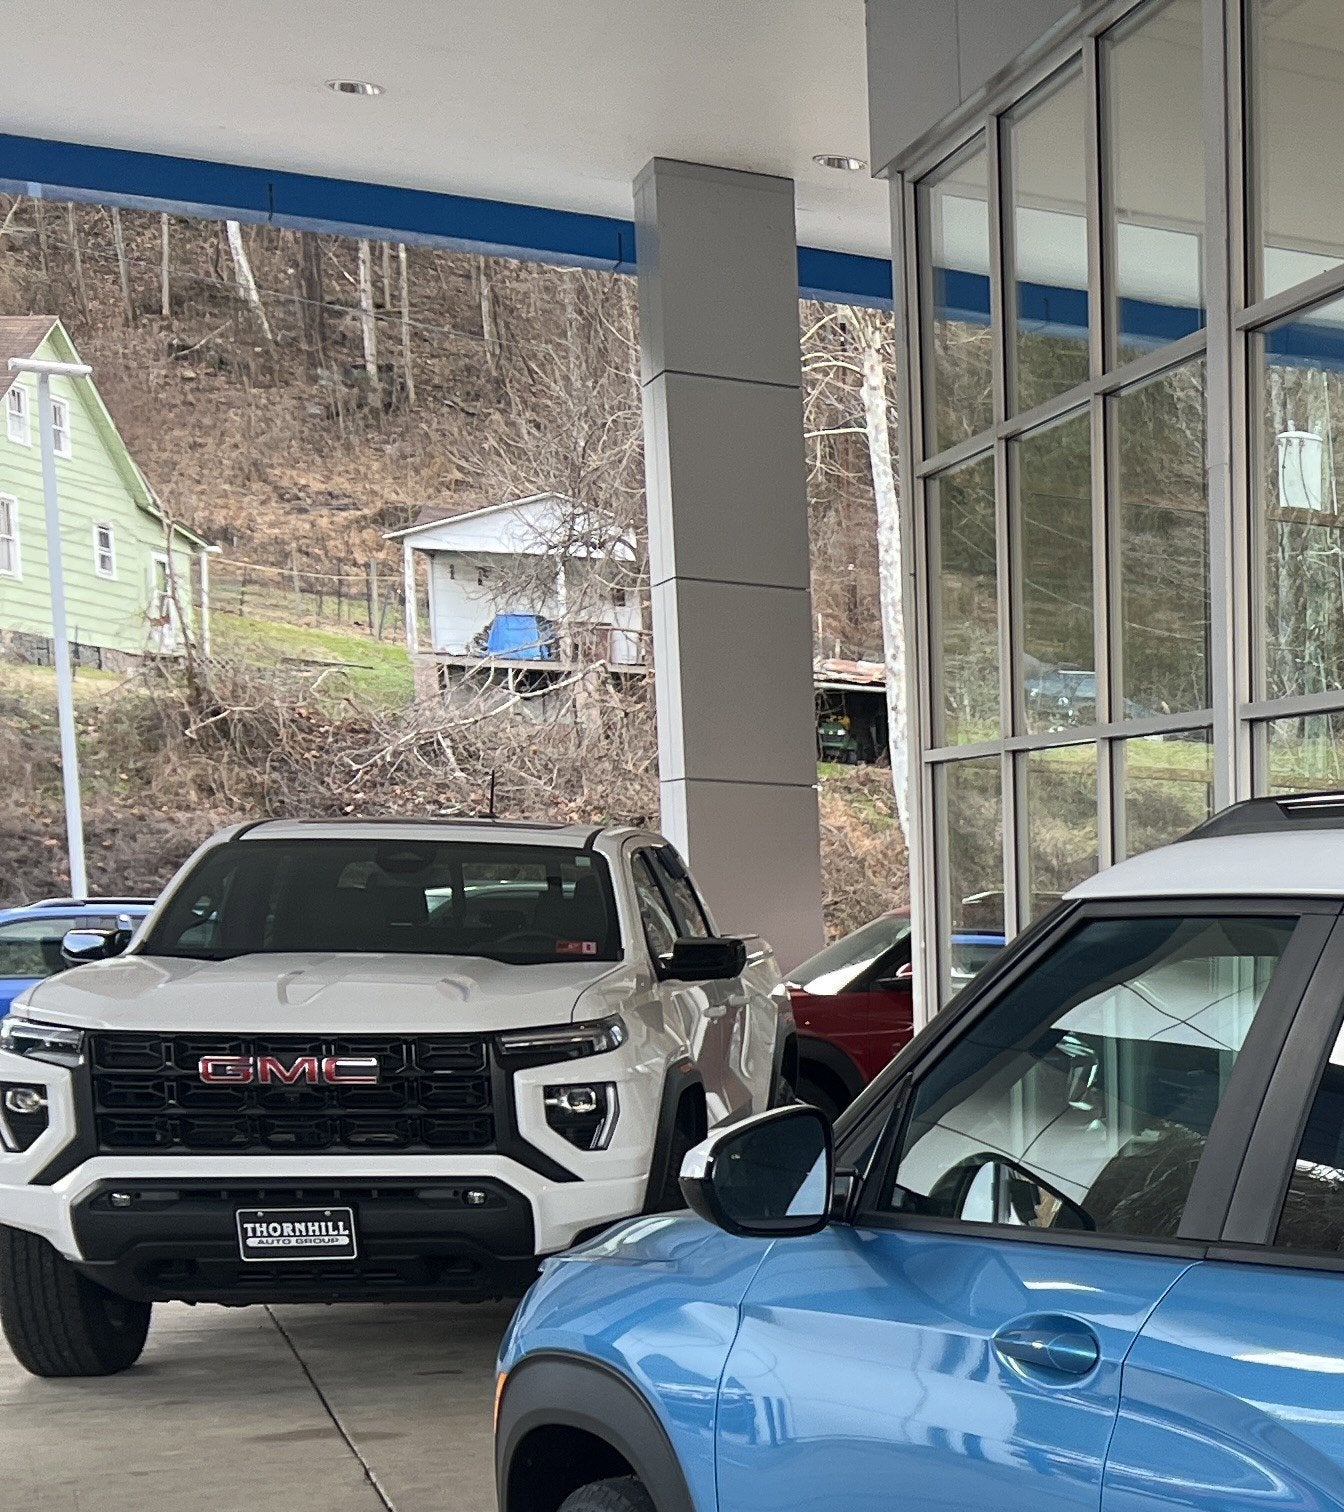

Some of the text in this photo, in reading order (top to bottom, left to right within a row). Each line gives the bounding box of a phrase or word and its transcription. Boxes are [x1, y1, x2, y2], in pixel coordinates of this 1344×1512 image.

[199, 1055, 377, 1084] GMC
[243, 1221, 350, 1237] THORNHILL
[295, 1237, 340, 1245] GROUP
